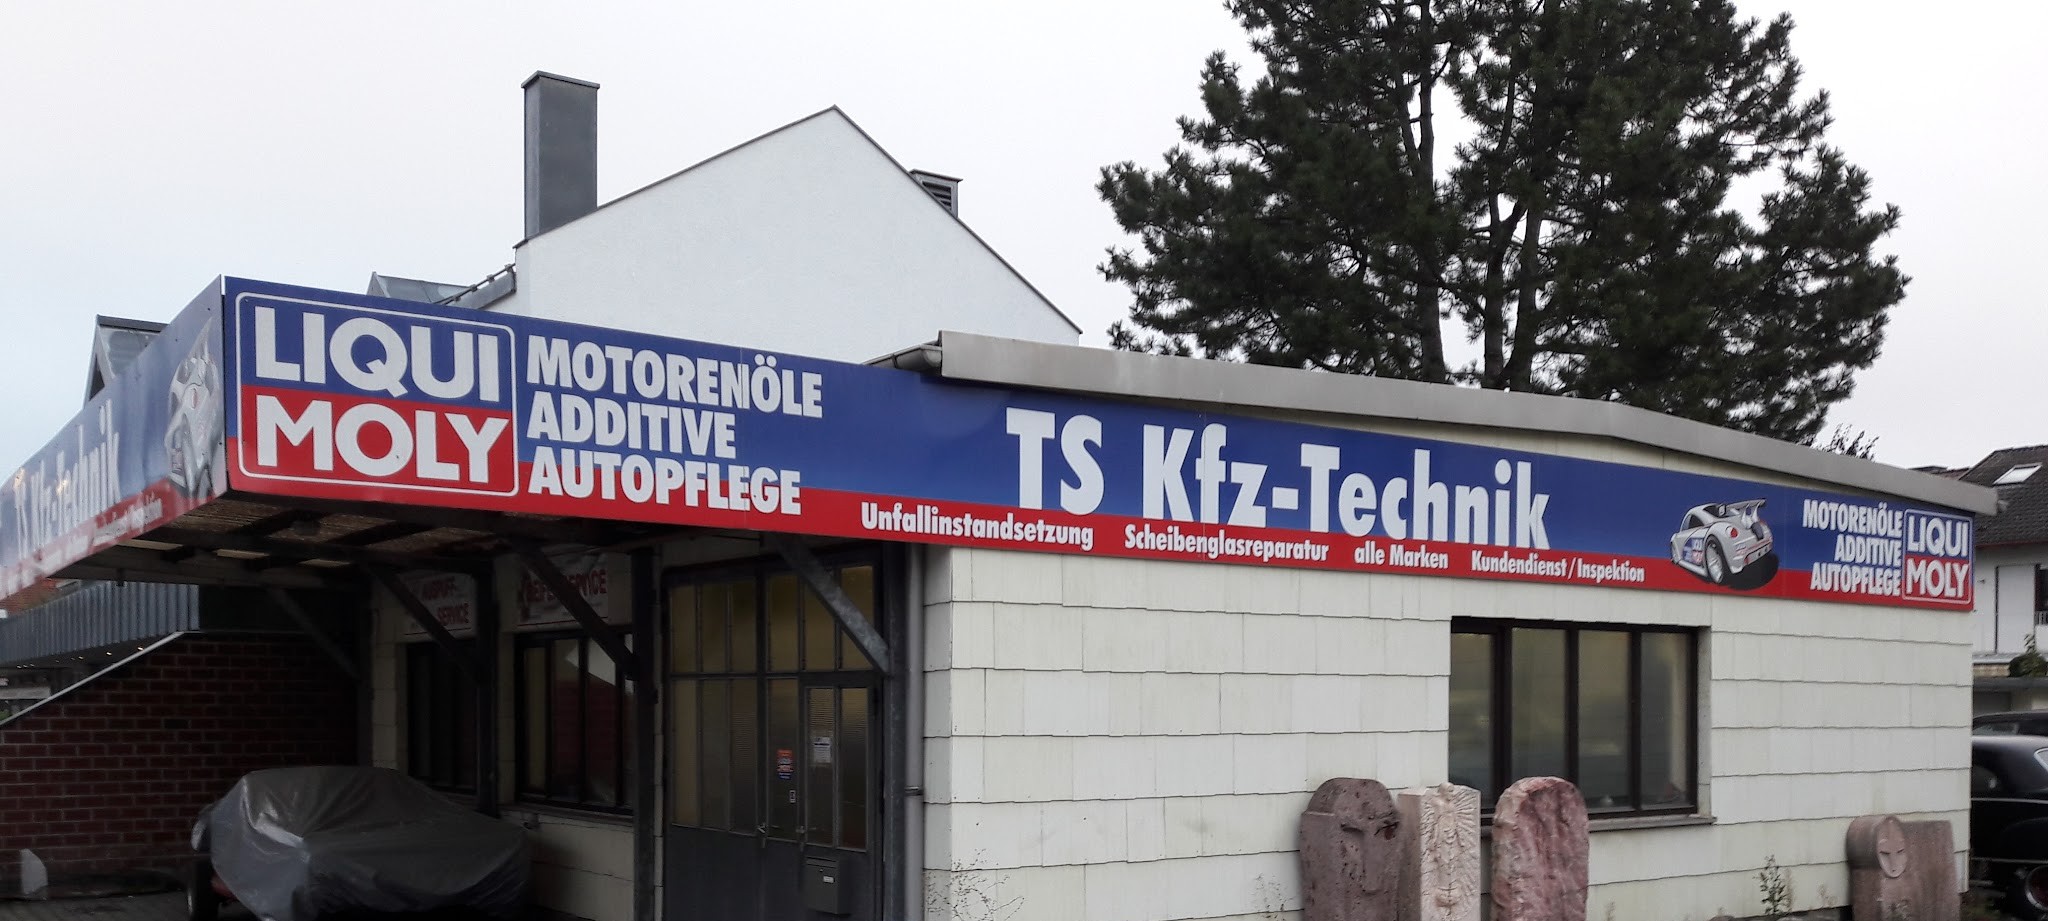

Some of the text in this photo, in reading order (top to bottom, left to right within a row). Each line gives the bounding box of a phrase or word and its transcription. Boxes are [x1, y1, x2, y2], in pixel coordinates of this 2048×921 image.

[255, 306, 500, 402] LIQUI
[526, 335, 823, 418] MOTORENÖLE
[256, 393, 509, 483] MOLY
[526, 391, 737, 459] ADDITIVE
[527, 446, 801, 516] AUTOPFLEGE
[1006, 407, 1551, 551] TS Kfz-Technik
[861, 501, 1094, 552] Unfallinstandsetzung
[1802, 499, 1904, 537] MOTORENÖLE
[1907, 514, 1969, 558] LIQUI
[1124, 523, 1330, 563] Scheibenglasreparatur
[1354, 539, 1449, 570] alle Marken
[1834, 535, 1902, 567] ADDITIVE
[1810, 562, 1901, 597] AUTOPFLEGE
[1906, 558, 1970, 598] MOLY
